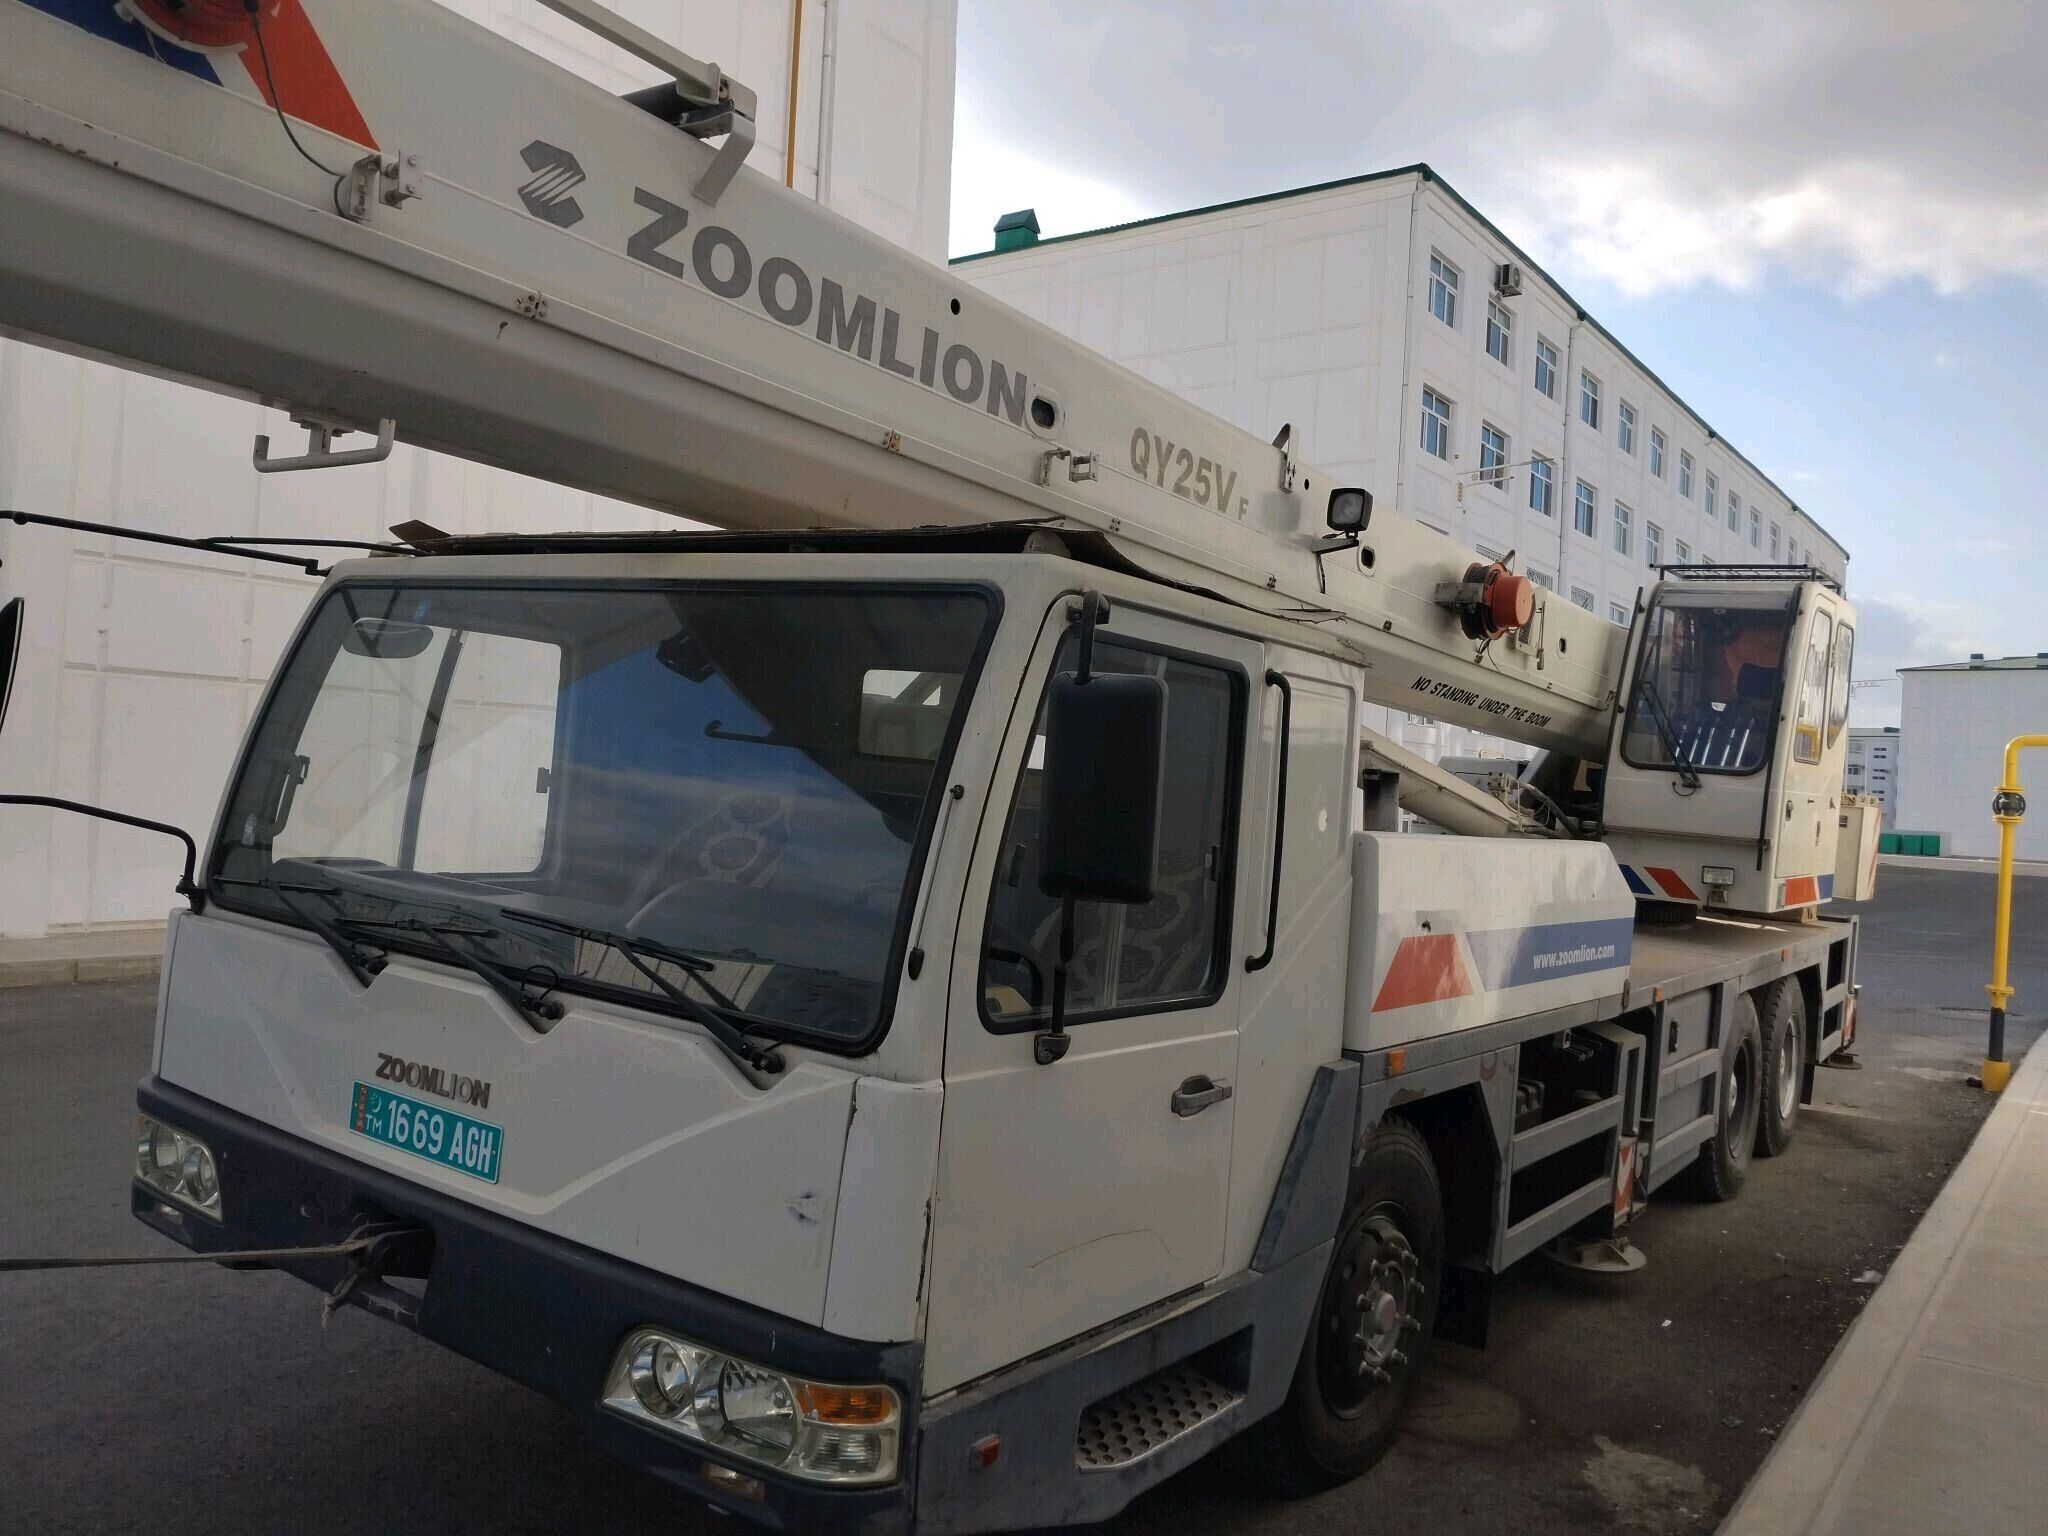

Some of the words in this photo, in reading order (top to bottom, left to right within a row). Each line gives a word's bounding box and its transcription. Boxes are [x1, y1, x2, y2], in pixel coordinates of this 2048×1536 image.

[626, 186, 1028, 426] ZOOMLION
[1130, 427, 1238, 514] QY25V
[1238, 496, 1250, 521] F
[1411, 676, 1432, 690] NO
[1430, 682, 1480, 706] STANDING
[1478, 697, 1510, 716] UNDER
[1507, 706, 1529, 721] THE
[1524, 712, 1552, 728] BOOM
[1533, 944, 1615, 969] www.zoomlion.com
[375, 1052, 491, 1109] ZOOMLION
[365, 1114, 382, 1135] TM
[388, 1100, 444, 1154] 1669
[448, 1121, 494, 1174] AGH
